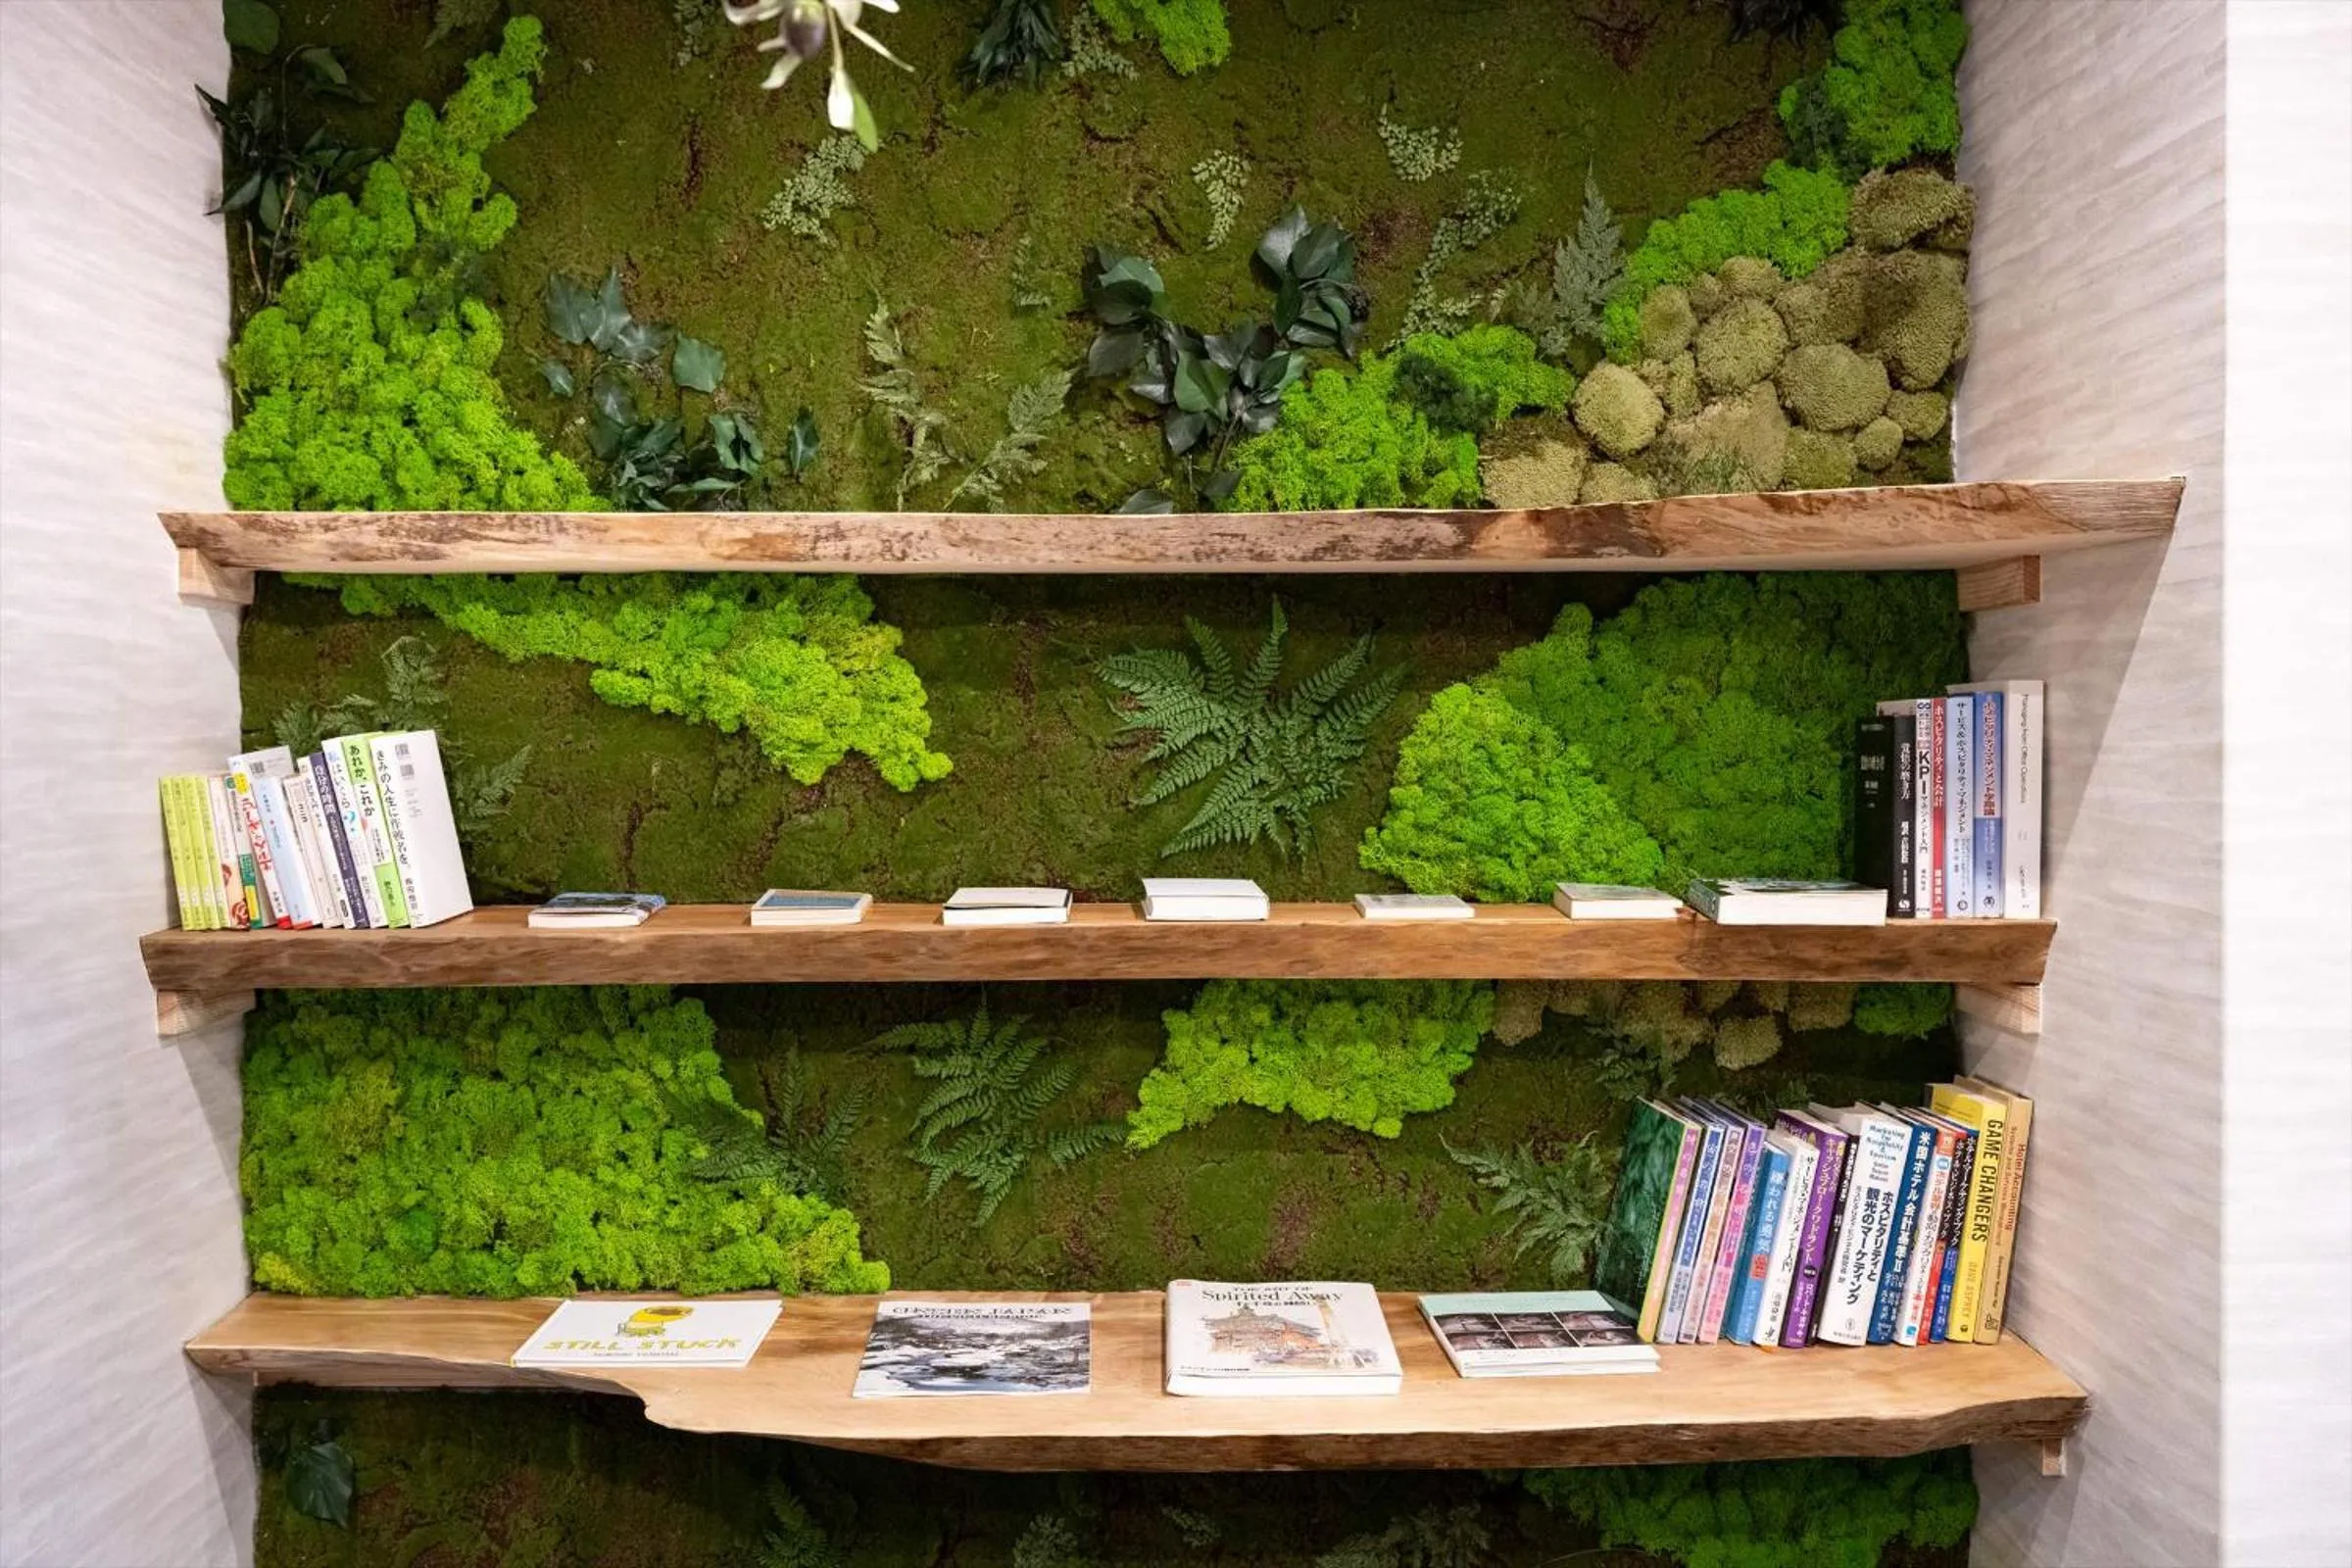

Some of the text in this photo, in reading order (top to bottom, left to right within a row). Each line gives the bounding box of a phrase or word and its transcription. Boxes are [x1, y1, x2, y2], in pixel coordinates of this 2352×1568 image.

[349, 745, 375, 817] あれか、これか
[1870, 1125, 1905, 1139] Marketing
[1972, 1119, 2004, 1243] GAME CHANGERS
[2004, 1144, 2027, 1231] Hotel Accounting
[1846, 1187, 1881, 1305] 観光のマーケティング
[1867, 1191, 1894, 1282] ホスピタリティと
[1201, 1291, 1343, 1303] Spirited Away
[543, 1337, 742, 1351] STILL STUCK
